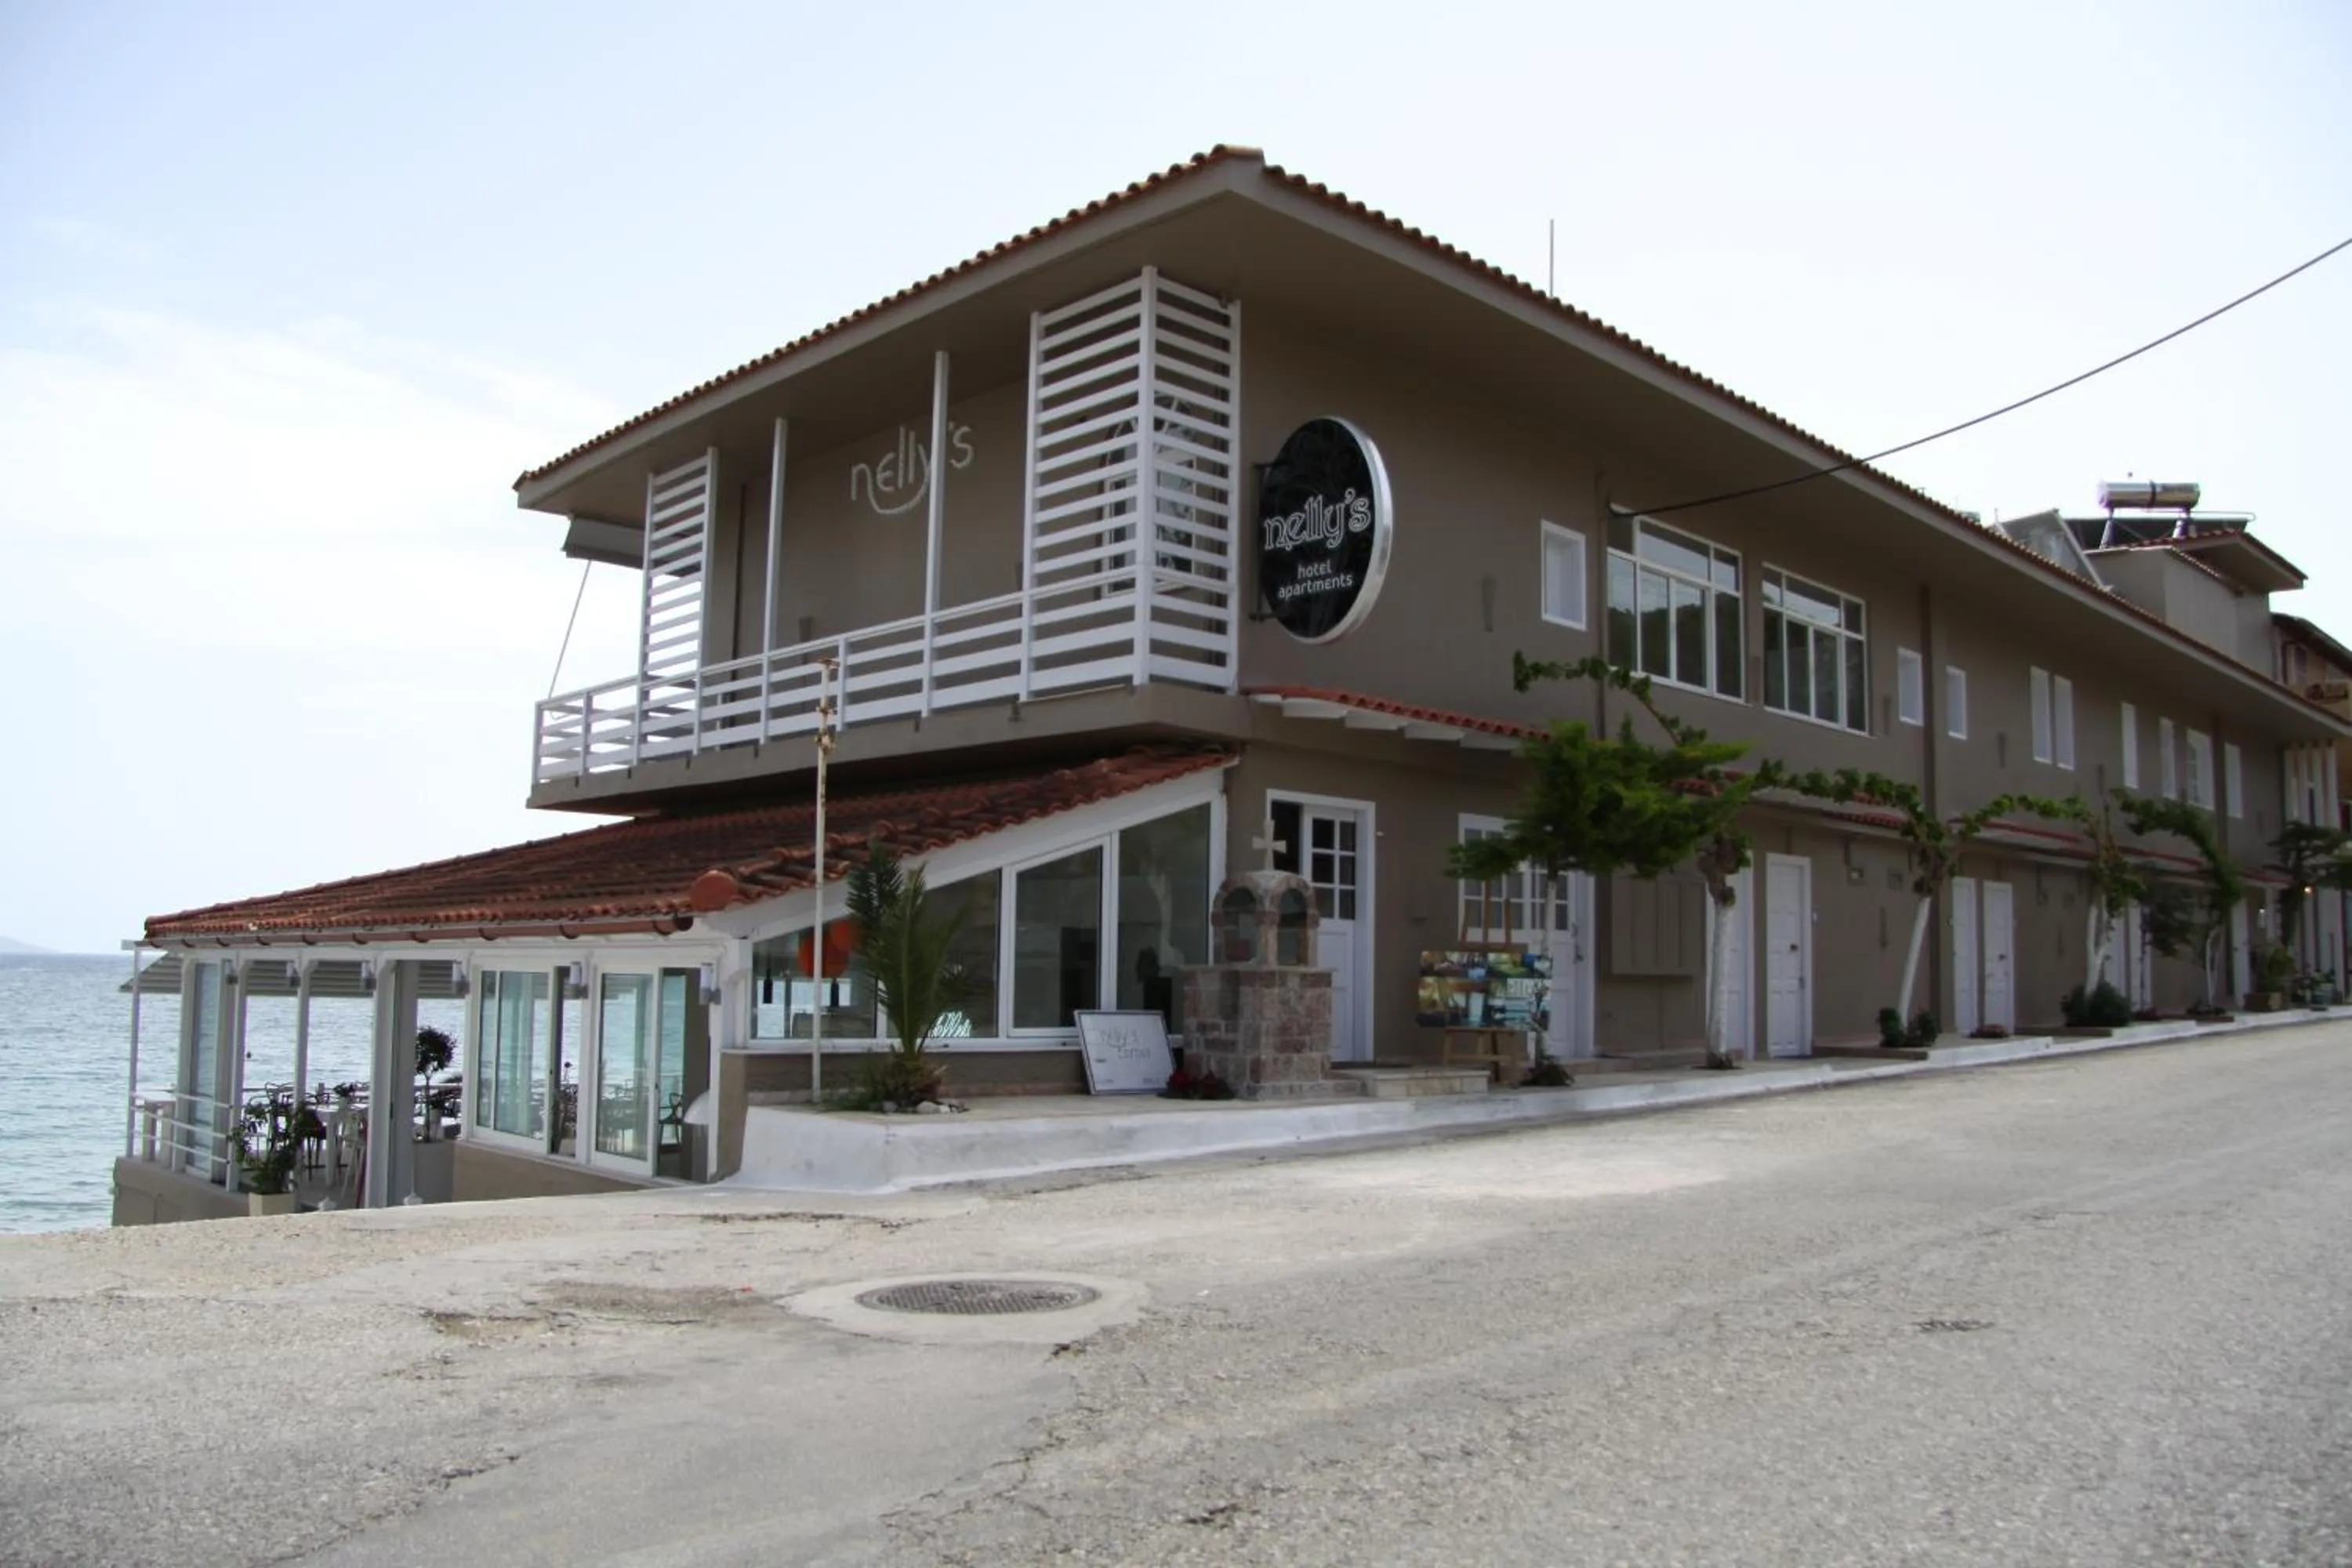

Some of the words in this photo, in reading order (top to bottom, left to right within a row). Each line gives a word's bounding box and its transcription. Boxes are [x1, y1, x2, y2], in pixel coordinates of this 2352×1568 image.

[1264, 488, 1371, 551] nelly's
[1298, 558, 1332, 579] hotel
[1279, 573, 1353, 601] apartments
